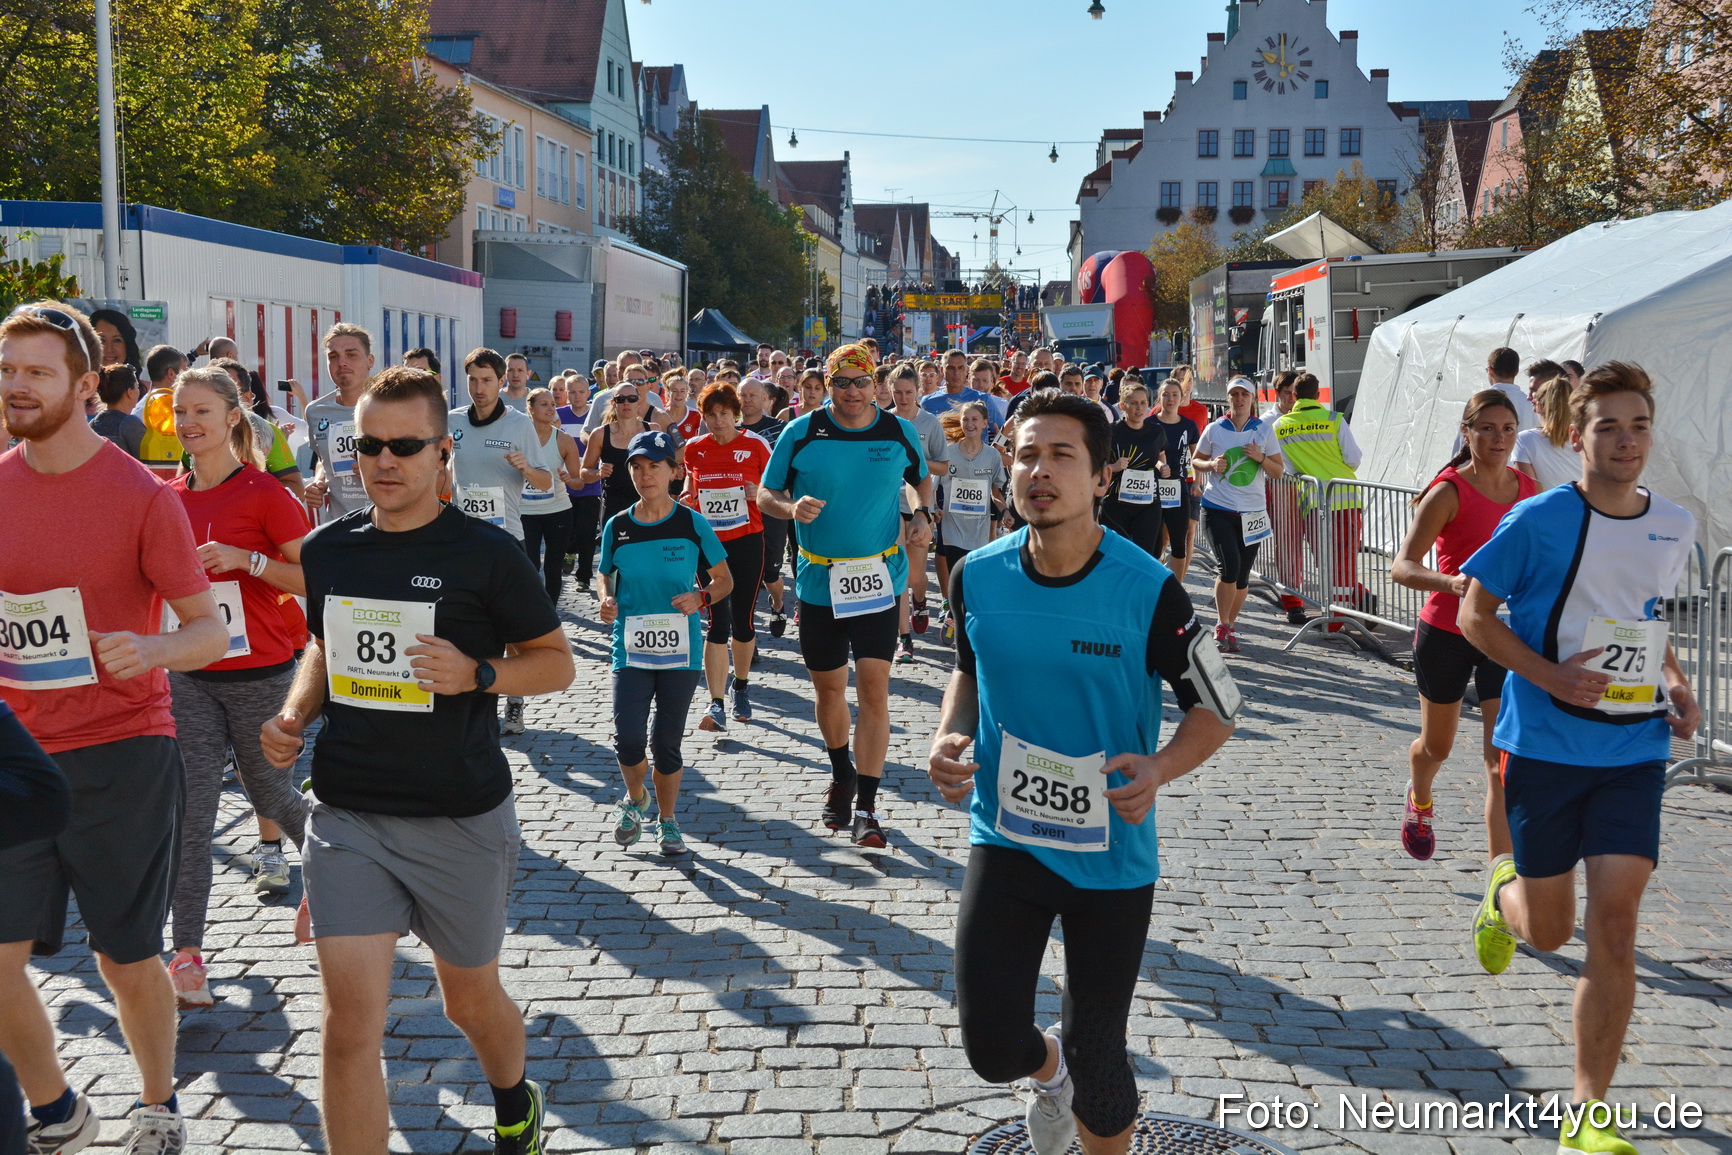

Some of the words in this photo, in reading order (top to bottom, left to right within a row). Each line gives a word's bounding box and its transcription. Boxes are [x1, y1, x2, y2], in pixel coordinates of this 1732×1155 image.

[936, 298, 969, 306] START
[1280, 423, 1330, 436] Org.-Leiter
[486, 440, 511, 448] BOCK
[342, 476, 356, 485] 19.
[1126, 479, 1150, 490] 2554
[956, 488, 982, 500] 2068
[463, 499, 495, 513] 2631
[706, 499, 738, 513] 2247
[1248, 516, 1266, 531] 2257
[847, 564, 872, 572] BOCK
[840, 574, 883, 594] 3035
[4, 600, 47, 613] BOCK
[353, 608, 401, 623] BOCK
[0, 615, 70, 650] 3004
[634, 630, 679, 648] 3039
[357, 630, 396, 664] 83
[1071, 640, 1122, 658] THULE
[4, 652, 21, 660] PARTL
[22, 651, 57, 660] Neumarkt
[1601, 644, 1646, 673] 275
[347, 666, 365, 675] PARTL
[366, 668, 400, 677] Neumarkt
[351, 681, 402, 699] Dominik
[1604, 687, 1634, 700] Lukas
[1027, 754, 1074, 777] BOCK
[1011, 769, 1091, 814] 2358
[1016, 805, 1038, 817] PARTL
[1040, 812, 1074, 823] Neumarkt
[1031, 823, 1065, 839] Sven
